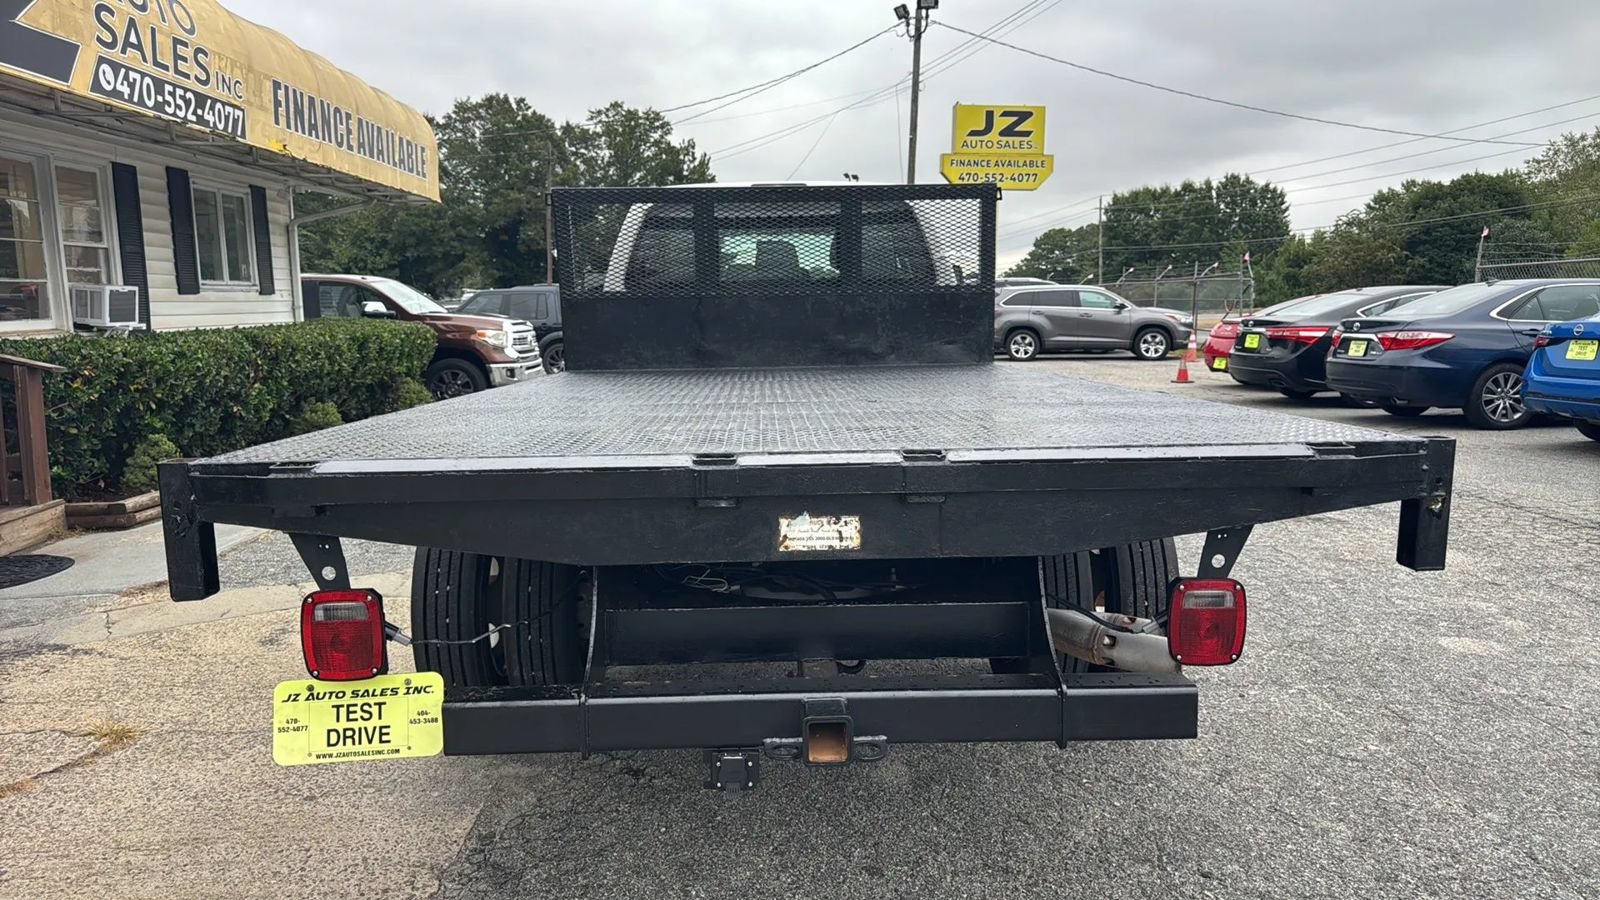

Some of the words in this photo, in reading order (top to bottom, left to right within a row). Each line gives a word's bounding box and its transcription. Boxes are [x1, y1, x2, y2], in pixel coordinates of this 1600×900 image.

[94, 2, 211, 88] SALES
[215, 71, 243, 100] INC
[115, 67, 244, 136] 470-552-4077
[272, 79, 354, 152] FINANCE
[357, 116, 427, 178] AVAILABLE
[966, 110, 1034, 137] JZ
[961, 140, 994, 149] AUTO
[996, 140, 1033, 149] SALES
[950, 159, 992, 168] FINANCE
[994, 160, 1046, 168] AVAILABLE
[958, 173, 1038, 182] 470-552-4077
[281, 693, 302, 703] JZ
[304, 690, 347, 702] AUTO
[350, 687, 400, 699] SALES
[403, 685, 435, 696] INC.
[331, 702, 387, 723] TEST
[326, 725, 392, 748] DRIVE
[315, 749, 401, 759] WWW.JZAUTOSALESINC.COM
